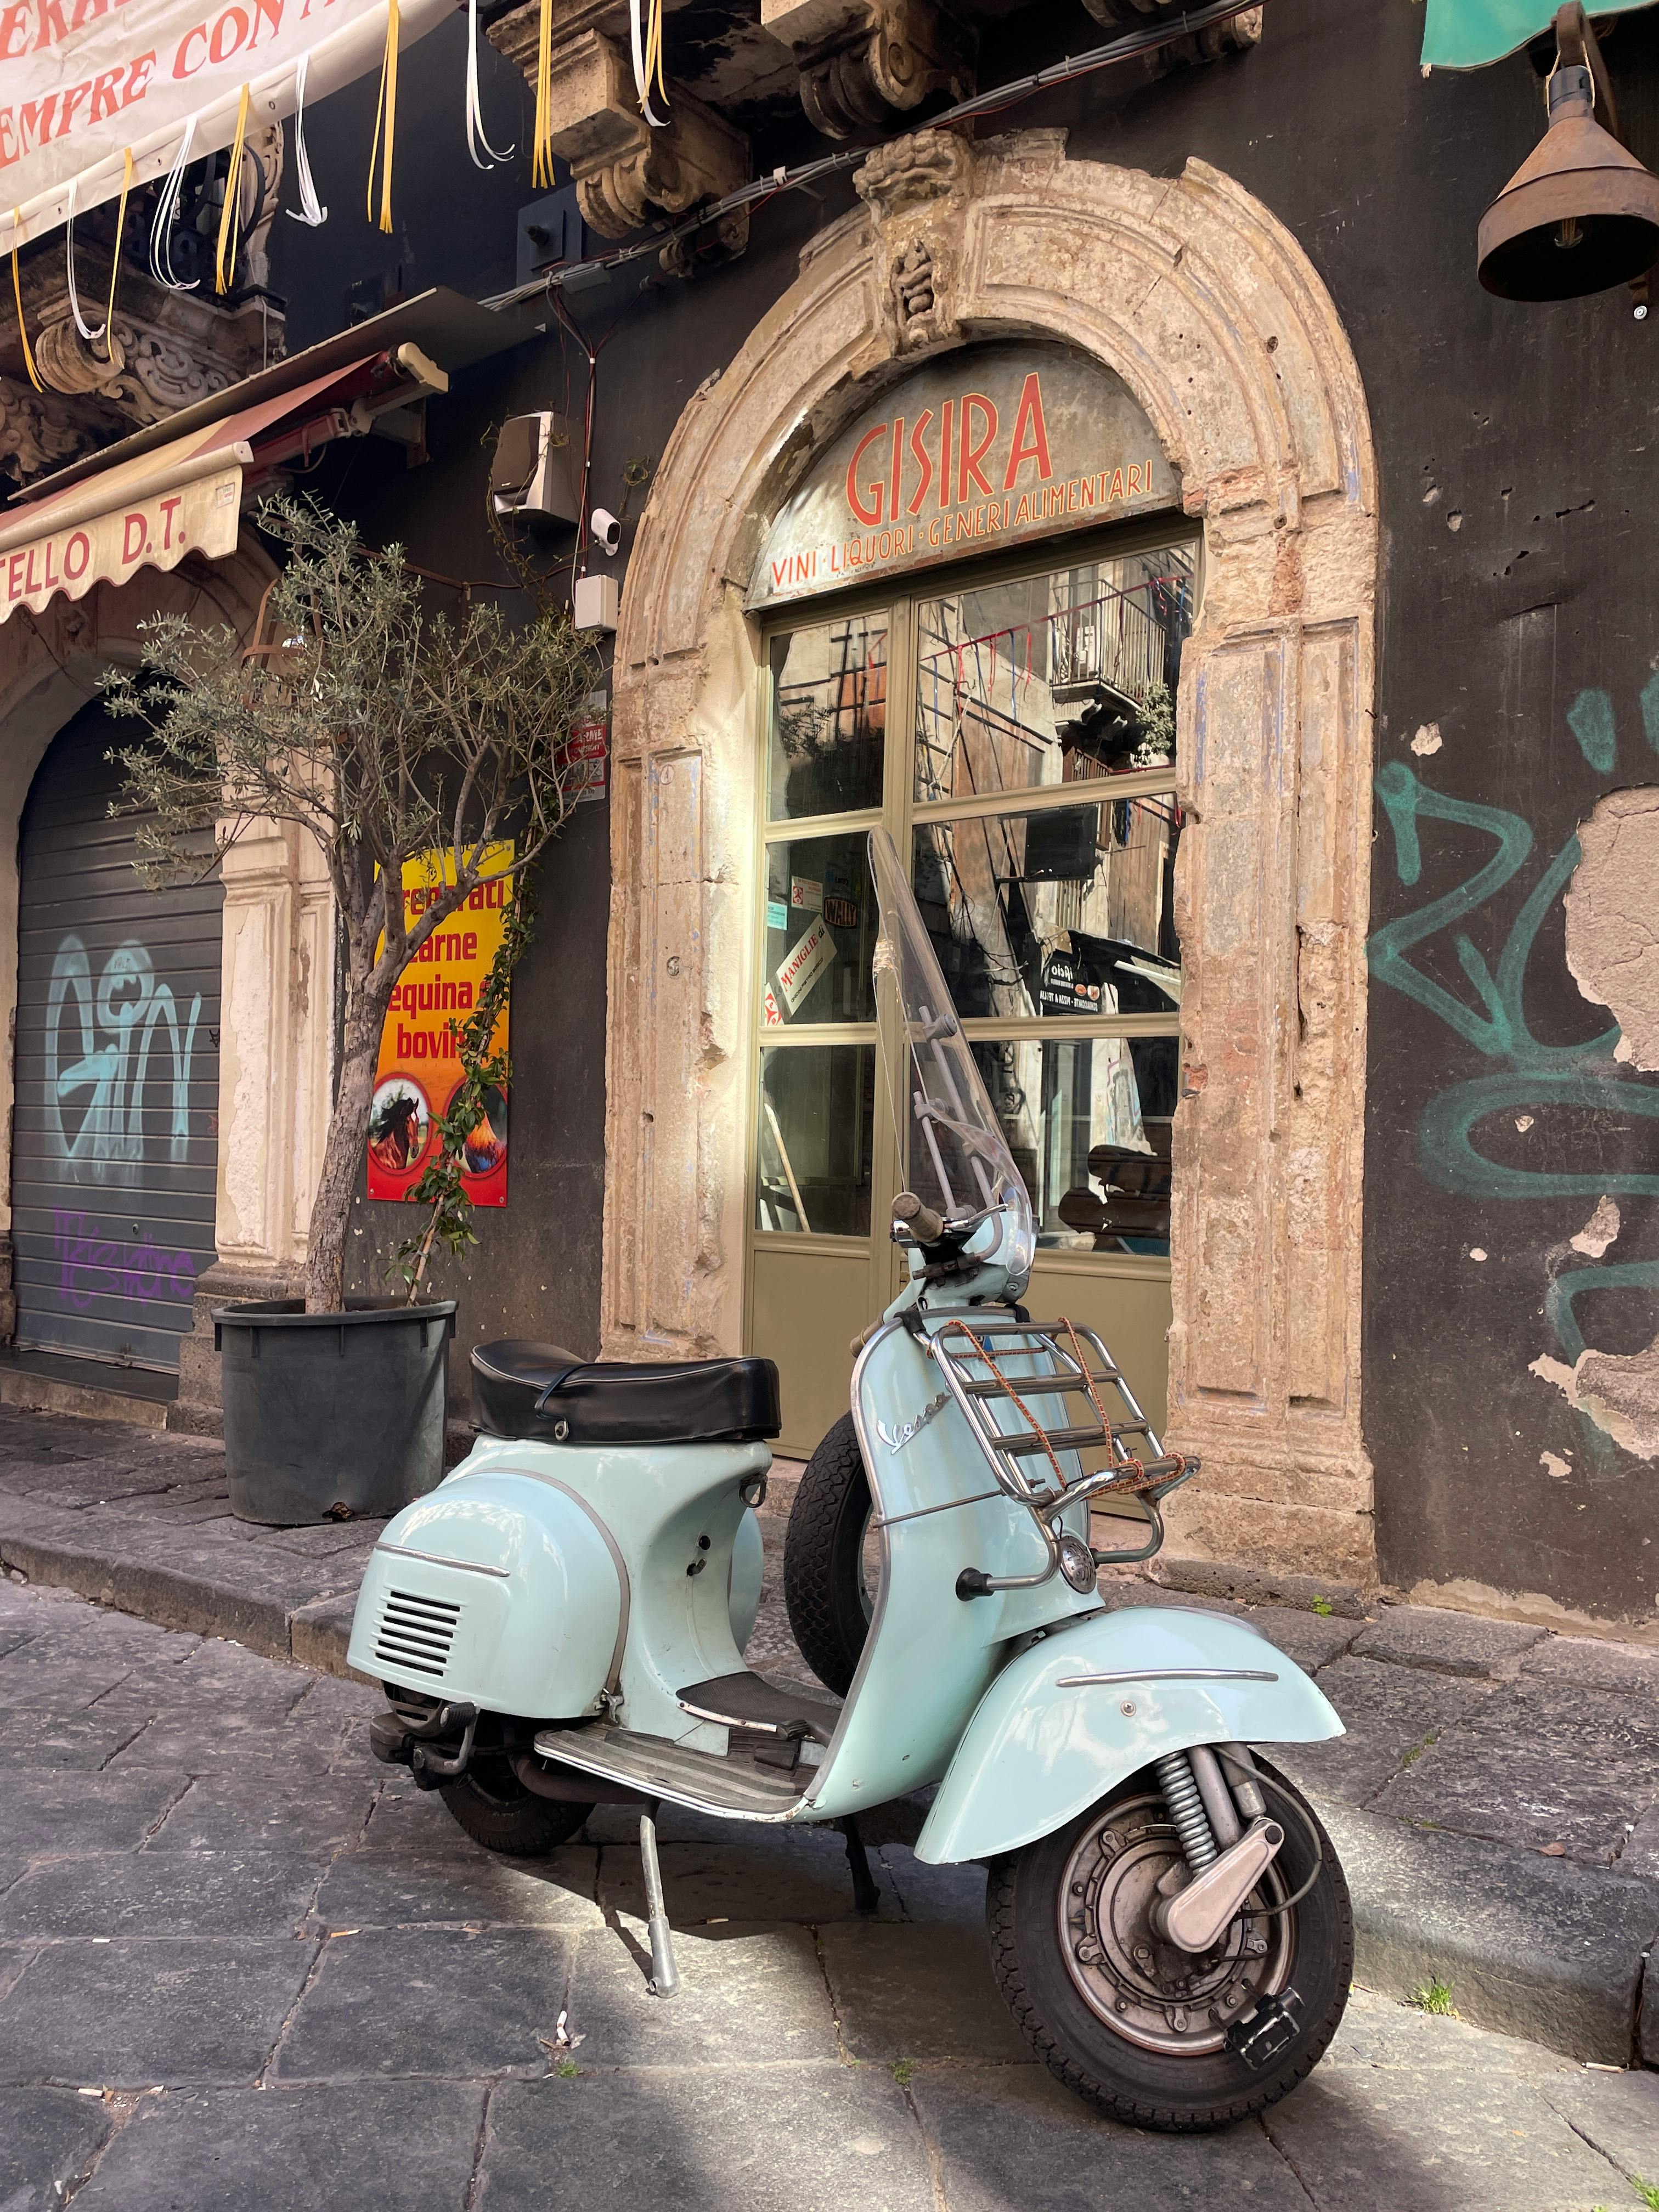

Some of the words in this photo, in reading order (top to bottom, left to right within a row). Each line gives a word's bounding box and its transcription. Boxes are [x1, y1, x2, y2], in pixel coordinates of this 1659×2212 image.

[172, 0, 284, 80] CON
[845, 371, 1053, 527] GISIRA
[772, 551, 816, 586] VINI
[831, 525, 913, 573] LIQUORI
[928, 499, 1009, 547] GENERI
[1014, 460, 1153, 526] ALIMENTARI
[0, 532, 89, 602] ELLO
[781, 934, 819, 992] MANIGLIE
[818, 924, 825, 939] di
[387, 974, 473, 1020] equina
[396, 1022, 465, 1059] bovin
